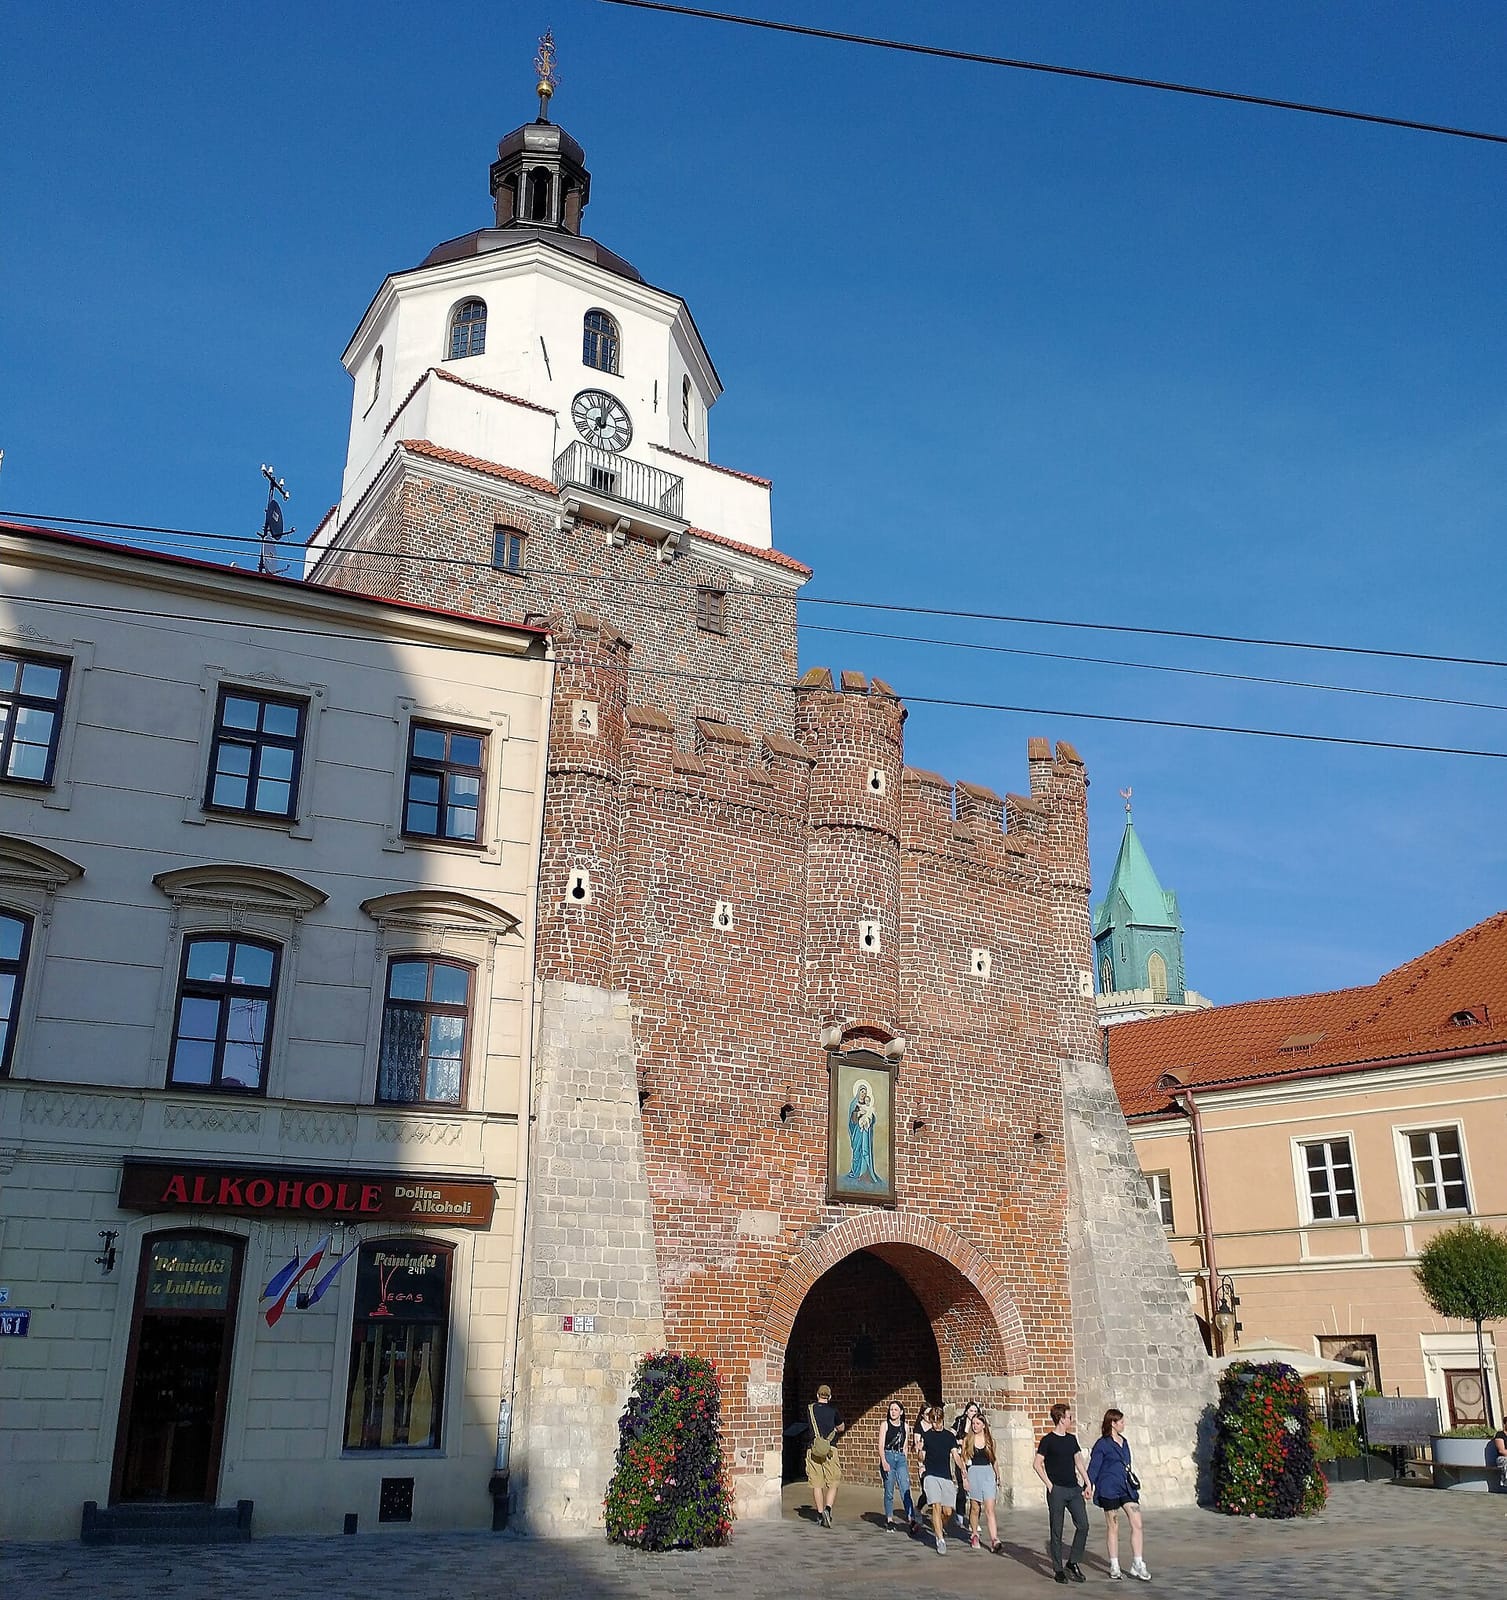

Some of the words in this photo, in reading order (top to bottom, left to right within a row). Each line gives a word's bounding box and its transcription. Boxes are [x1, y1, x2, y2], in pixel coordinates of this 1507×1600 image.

[160, 1175, 383, 1212] ALKOHOLE
[394, 1186, 441, 1200] Dolina
[411, 1201, 472, 1215] Alkoholi
[165, 1279, 223, 1295] Lublina
